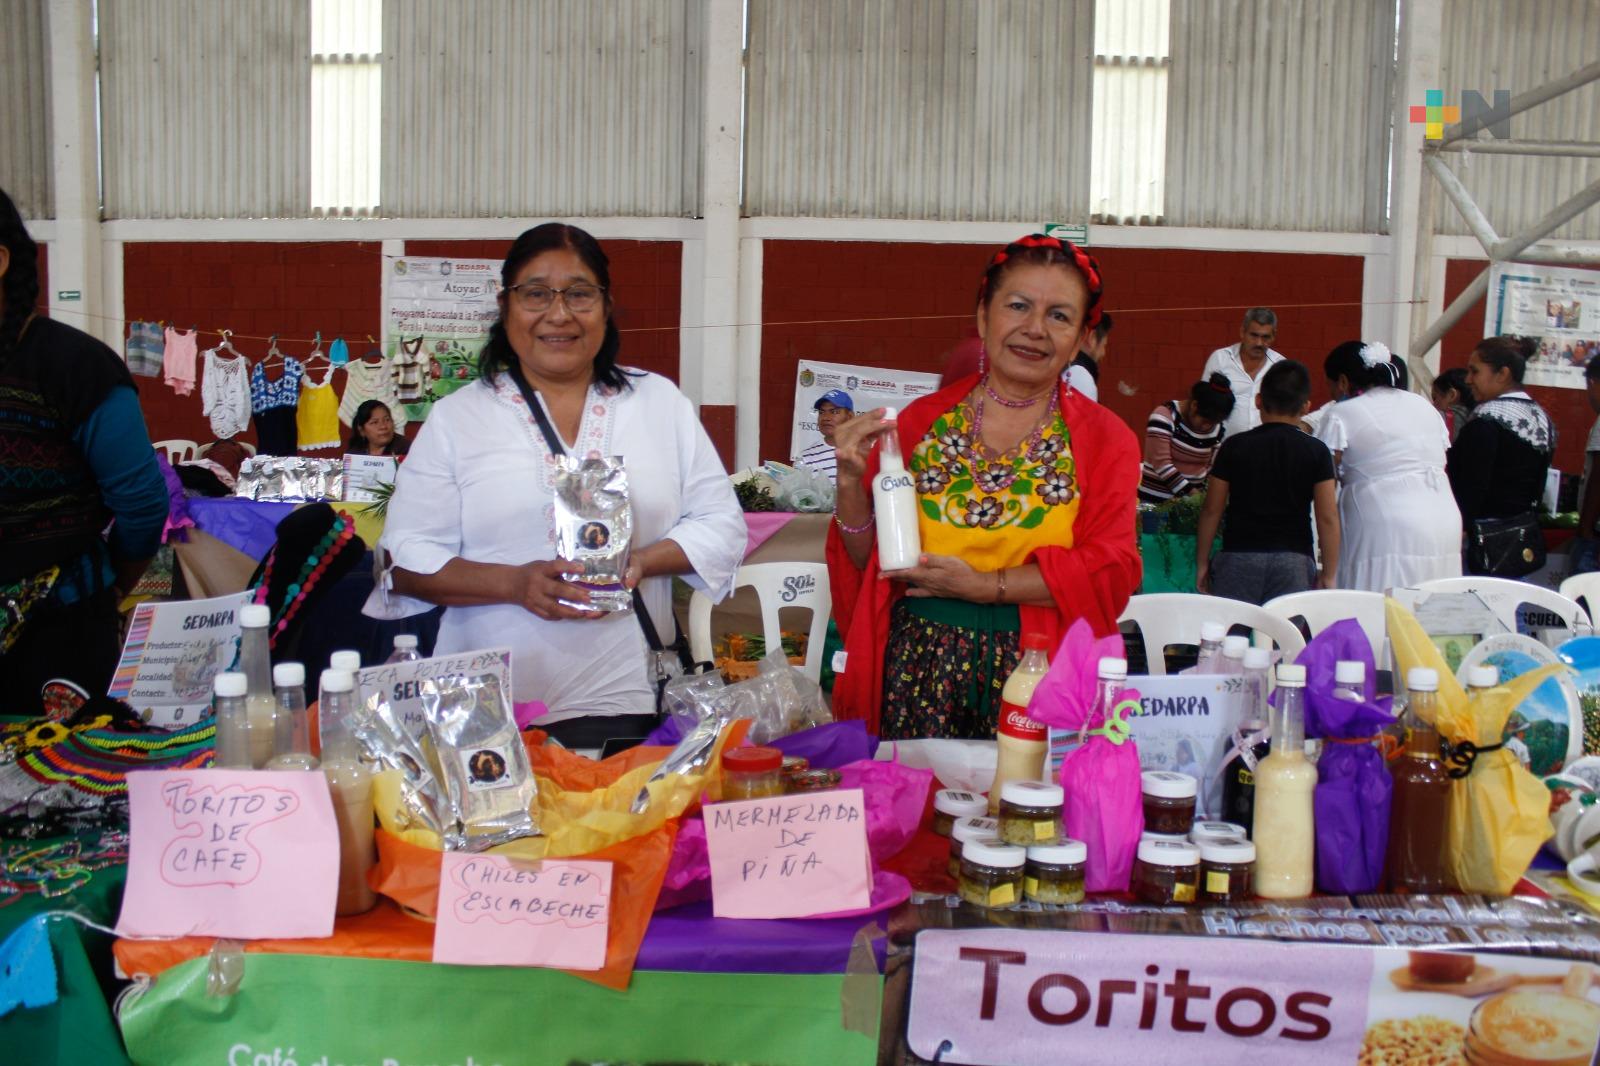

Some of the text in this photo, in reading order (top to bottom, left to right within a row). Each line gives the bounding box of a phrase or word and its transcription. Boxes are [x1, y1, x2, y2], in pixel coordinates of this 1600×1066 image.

[444, 283, 480, 296] Atoyac
[391, 307, 425, 320] Programa
[427, 308, 457, 320] Fomento
[398, 321, 414, 332] Para
[423, 322, 479, 333] Autosuficiencia
[861, 379, 897, 389] SEDARPA
[182, 609, 235, 630] SEDARPA
[166, 783, 293, 817] TORITOS
[714, 803, 860, 832] MERMELADA
[210, 822, 249, 842] DE
[774, 829, 817, 849] DE
[172, 848, 248, 872] CAFE
[461, 862, 591, 888] CHILES EN
[463, 891, 604, 919] ESCABECHE
[1202, 916, 1371, 940] Hechos
[1376, 924, 1451, 948] por
[959, 946, 1333, 1042] Toritos
